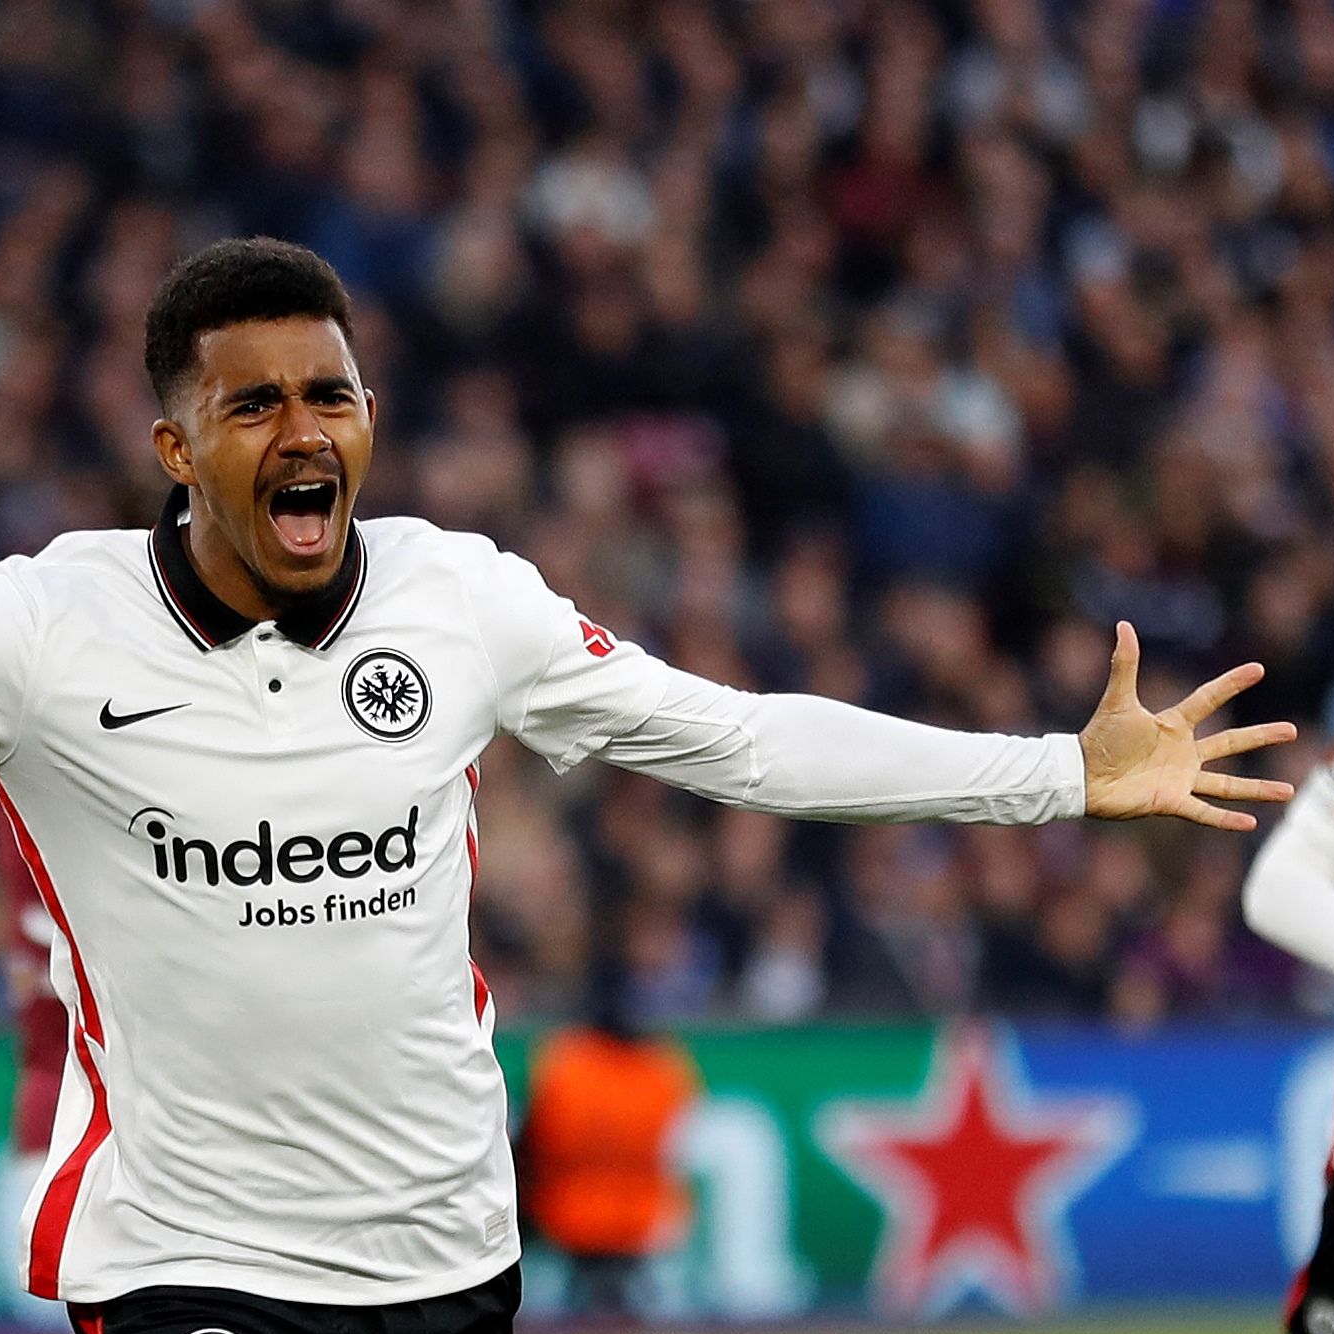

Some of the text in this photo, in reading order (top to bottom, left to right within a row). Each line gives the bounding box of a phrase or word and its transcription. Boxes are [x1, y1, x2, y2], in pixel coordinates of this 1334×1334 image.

[128, 805, 419, 887] indeed
[238, 886, 417, 927] Jobs finden
